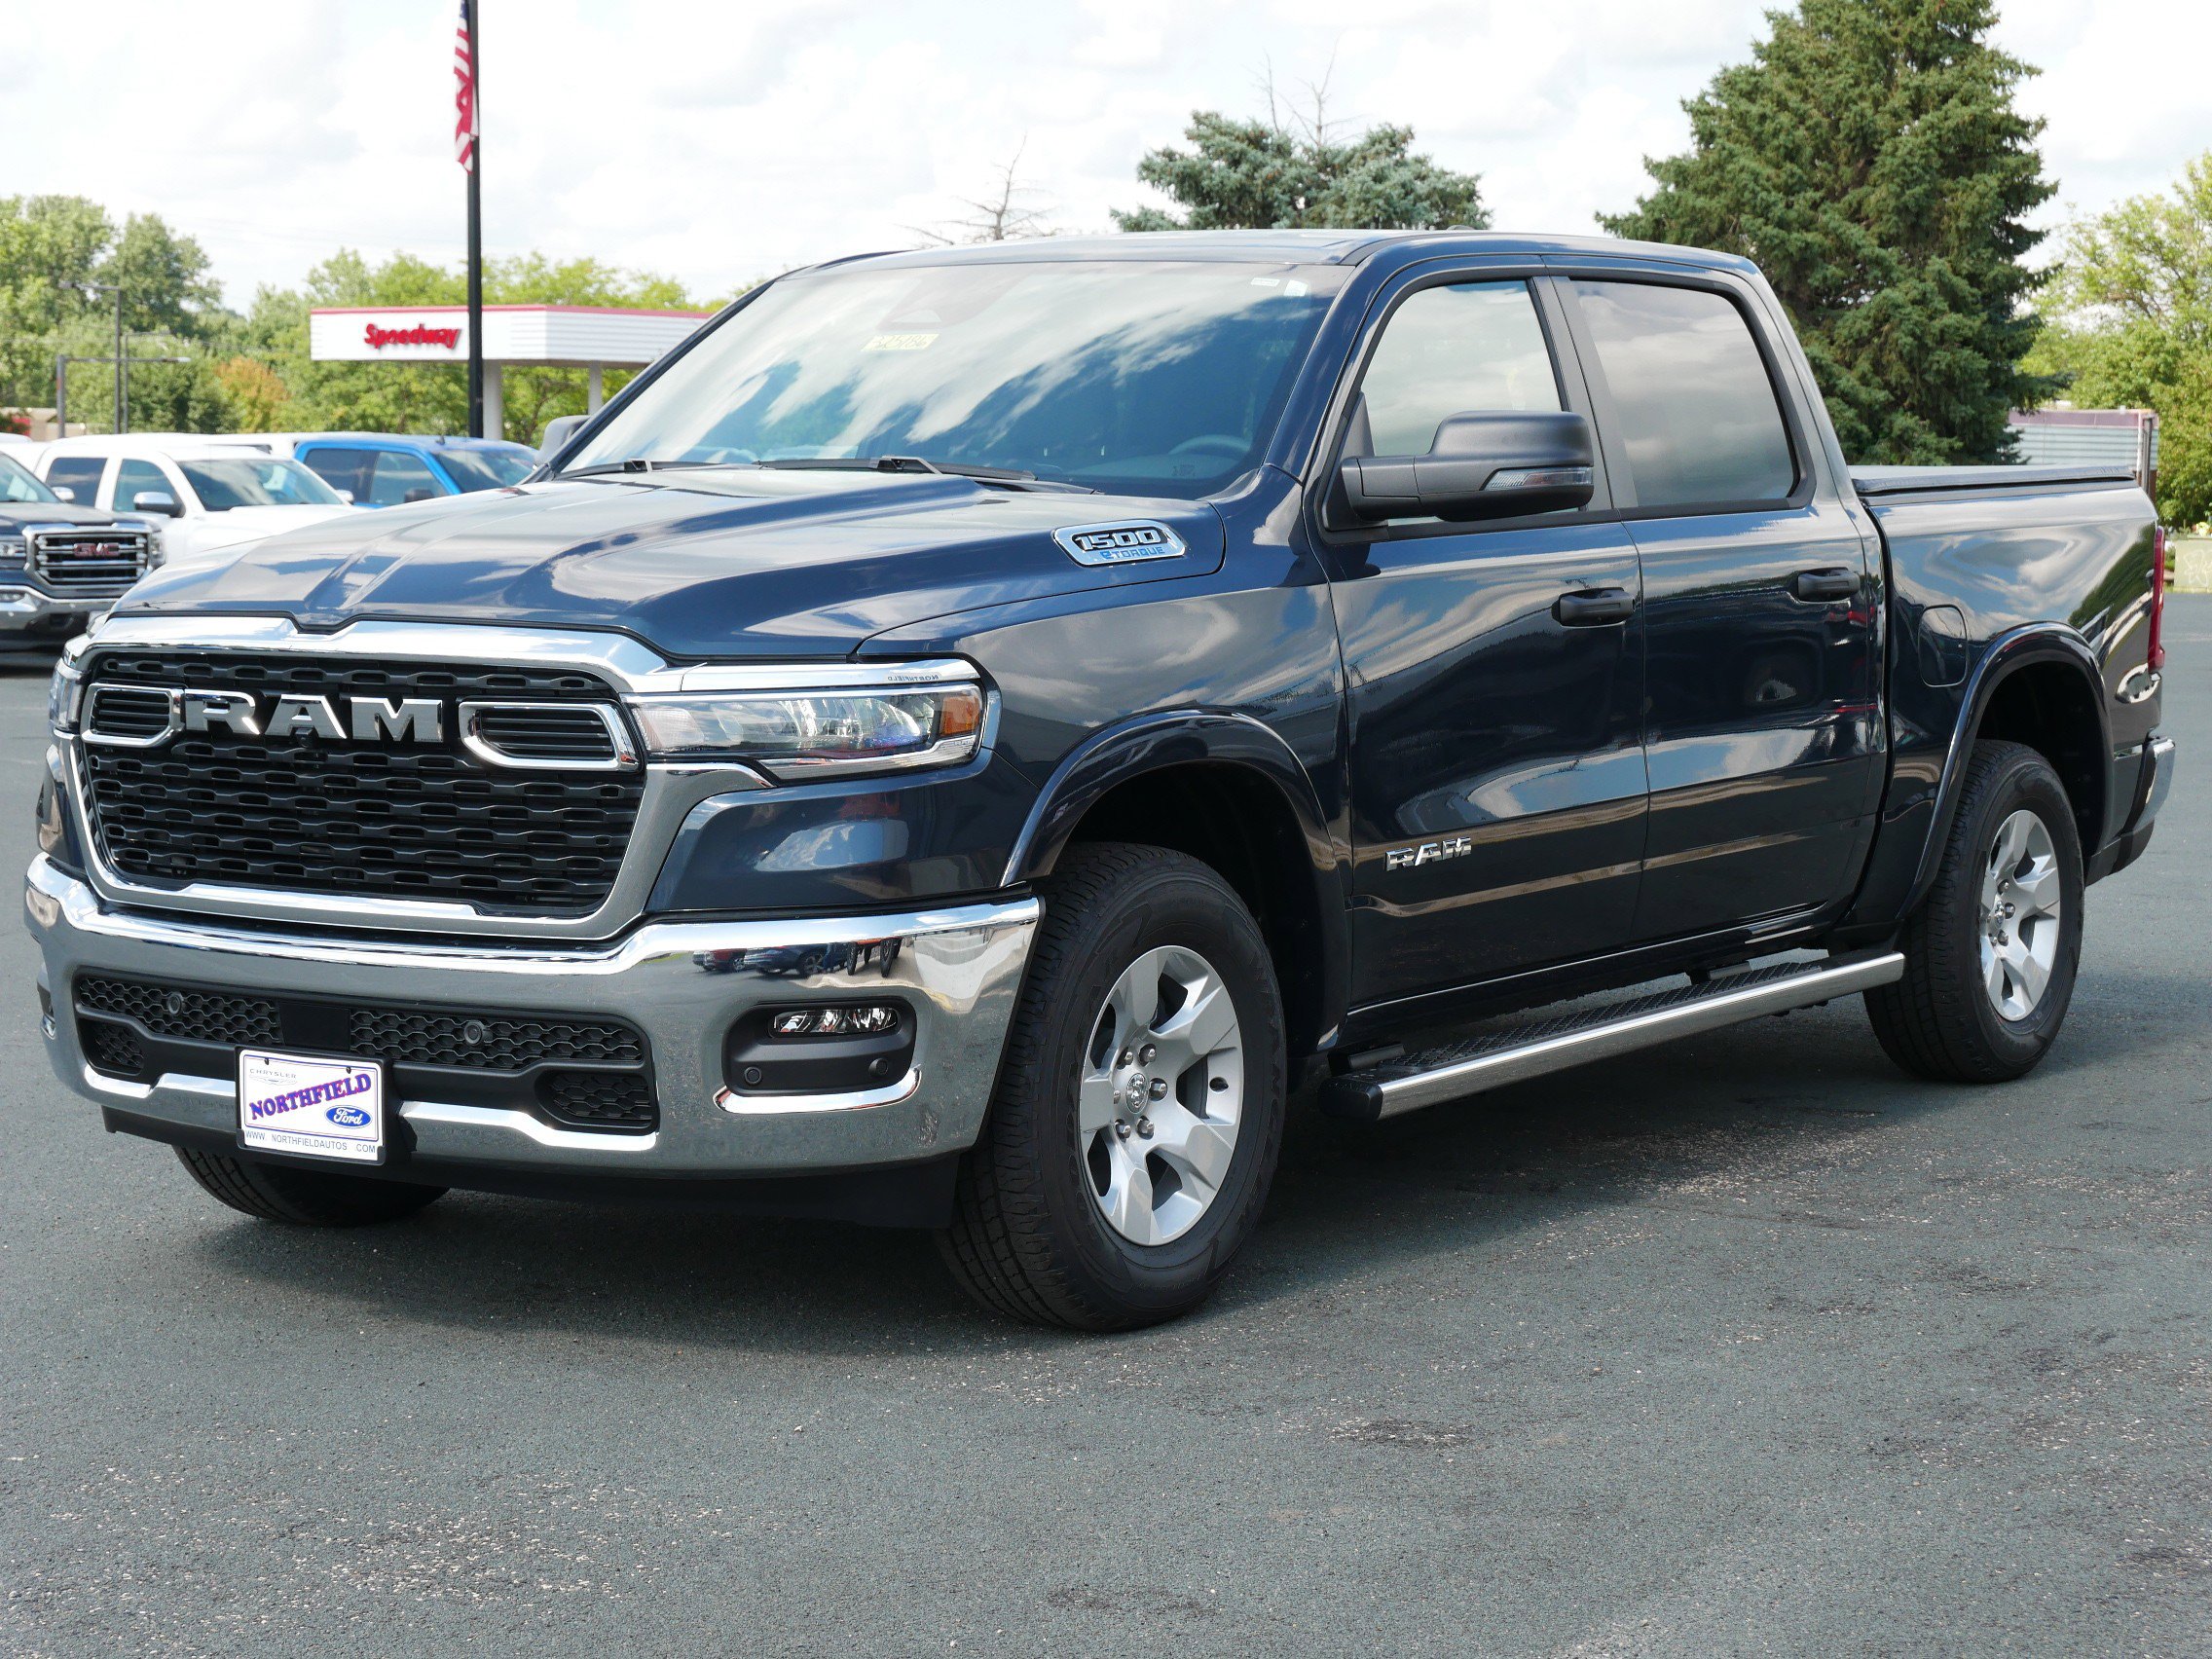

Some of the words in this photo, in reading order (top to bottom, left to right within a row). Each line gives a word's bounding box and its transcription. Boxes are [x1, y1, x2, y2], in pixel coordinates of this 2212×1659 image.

[364, 322, 461, 349] Speedway
[73, 542, 120, 557] GMC
[1075, 529, 1161, 551] 1500
[185, 688, 443, 743] RAM
[1384, 837, 1472, 871] RAM
[249, 1068, 297, 1079] CHRYSLER
[249, 1073, 372, 1121] NORTHFIELD
[333, 1108, 363, 1125] Ford
[272, 1134, 348, 1150] NORTHFIELDAUTOS
